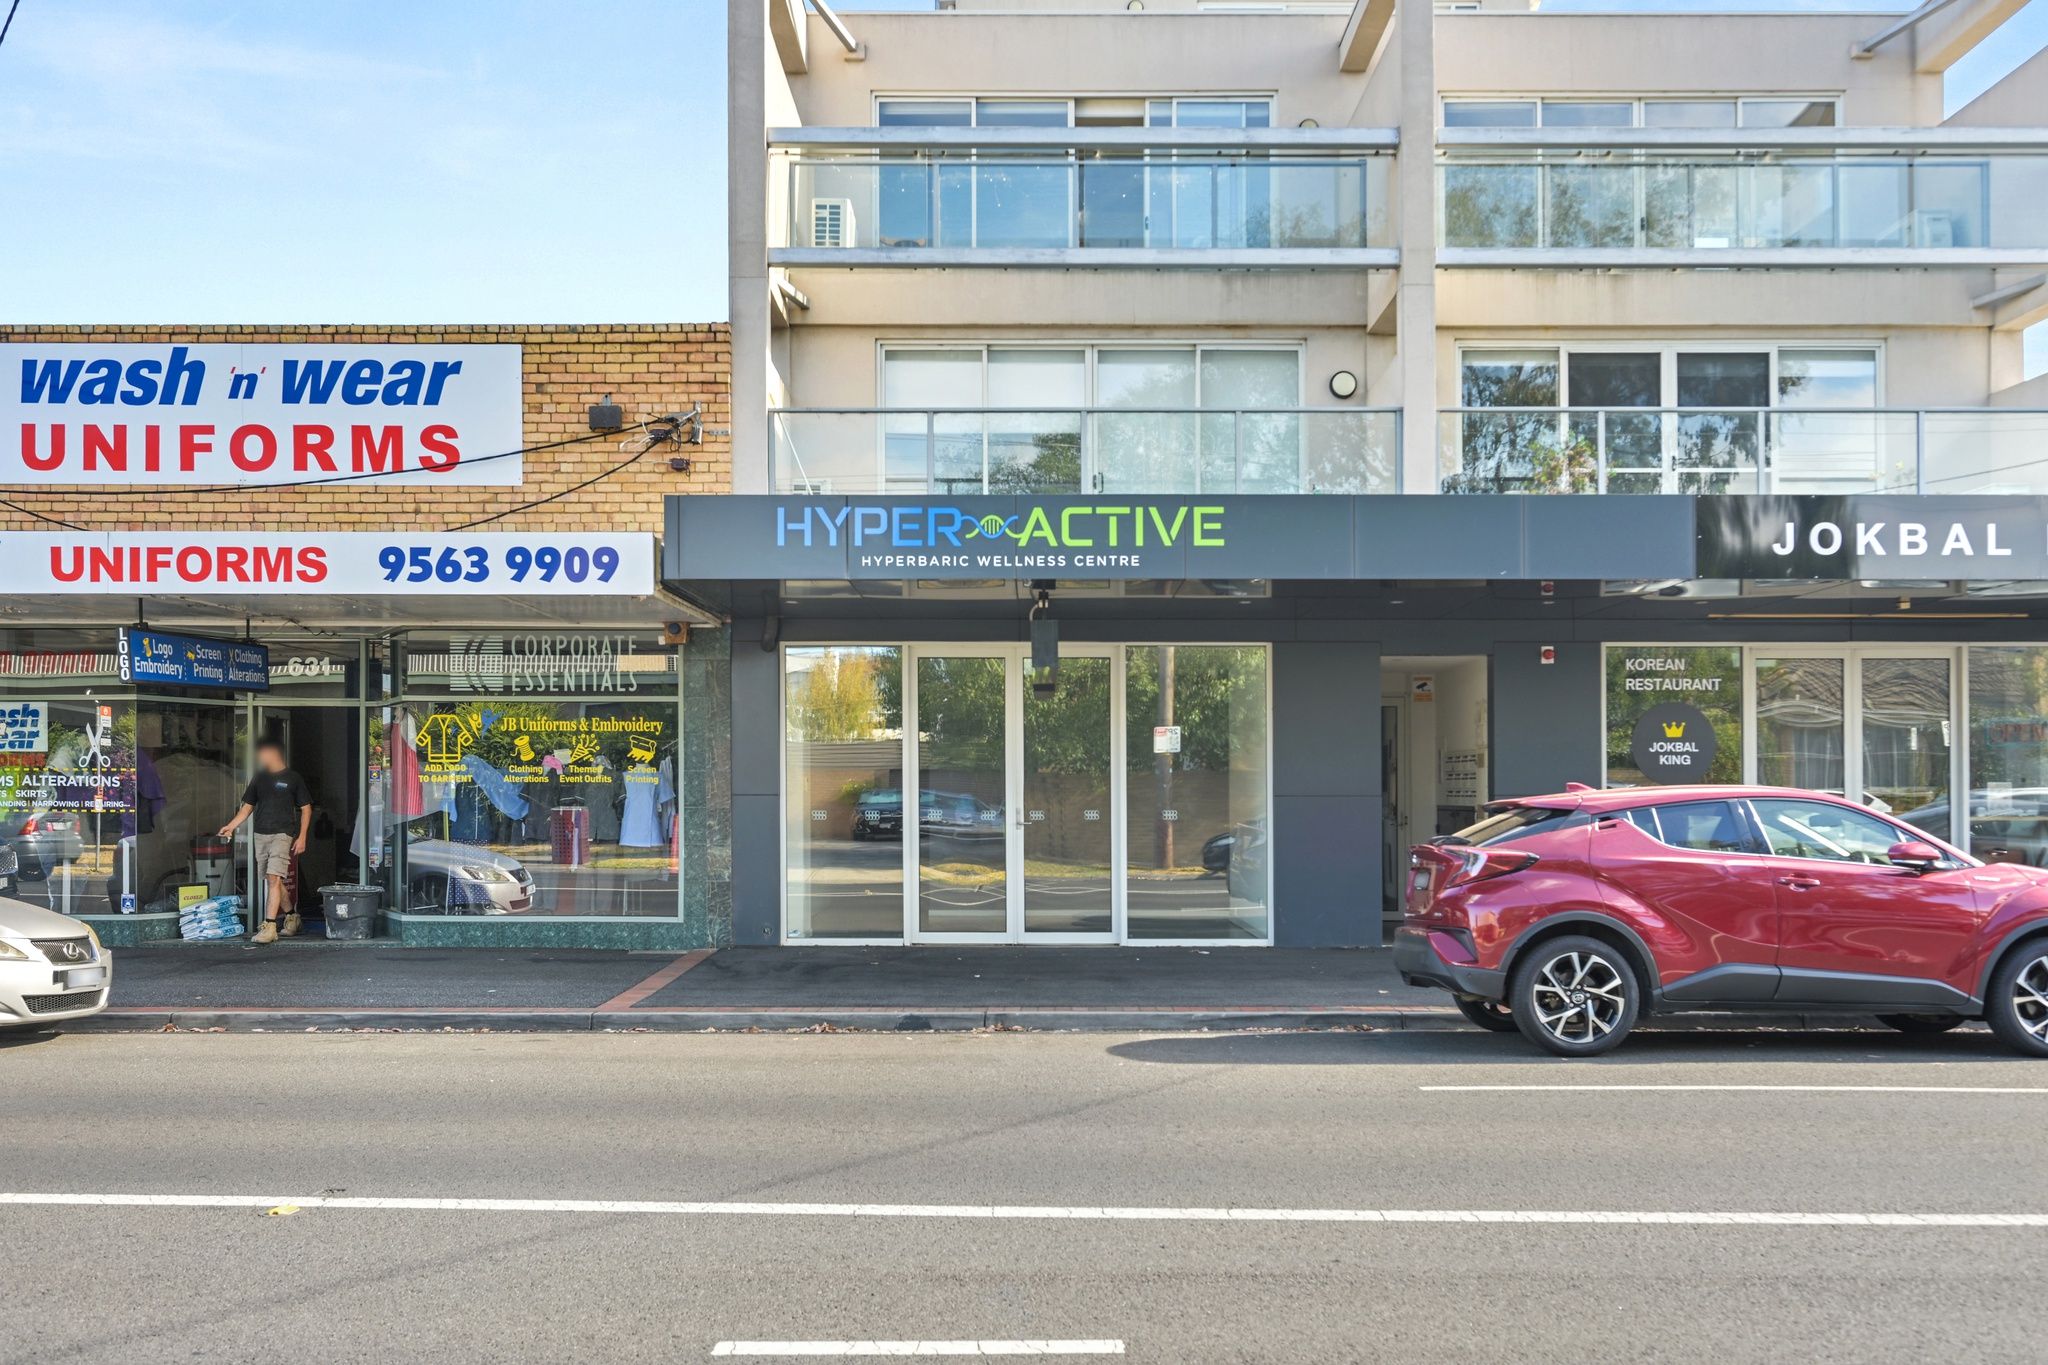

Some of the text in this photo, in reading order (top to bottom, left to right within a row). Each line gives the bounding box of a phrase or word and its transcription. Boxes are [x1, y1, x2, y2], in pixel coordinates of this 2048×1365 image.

[20, 347, 206, 405] wash
[281, 358, 463, 406] wear
[20, 423, 461, 473] UNIFORMS
[776, 506, 1225, 547] HYPER ACTIVE
[1772, 521, 2012, 556] JOKBAL
[50, 546, 620, 583] UNIFORMS 9563 9909
[861, 555, 1141, 567] HYPERBARIC WELLNESS CENTRE
[118, 627, 130, 681] LOGO
[153, 639, 173, 657] Logo
[196, 644, 222, 661] Screen
[511, 635, 637, 659] CORPORATE
[134, 656, 183, 679] Embroidery
[235, 650, 262, 668] Clothing
[288, 656, 330, 676] 631
[1625, 658, 1685, 671] KOREAN
[193, 662, 223, 682] Printing
[228, 667, 266, 684] Alterations
[511, 668, 638, 692] ESSENTIALS
[1625, 678, 1722, 691] RESTAURANT
[501, 716, 664, 735] JB Uniforms & Embroidery
[1649, 742, 1699, 753] JOKBAL
[424, 764, 467, 772] ADD LOGO
[1659, 755, 1691, 765] KING
[509, 765, 543, 775] Clothing
[627, 765, 656, 773] Screen
[21, 775, 121, 787] ALTERATIONS
[418, 775, 473, 783] TO GARMENT
[503, 775, 549, 783] Alterations
[559, 774, 612, 783] Event Outfits
[626, 775, 659, 785] Printing
[15, 790, 48, 798] SKIRTS
